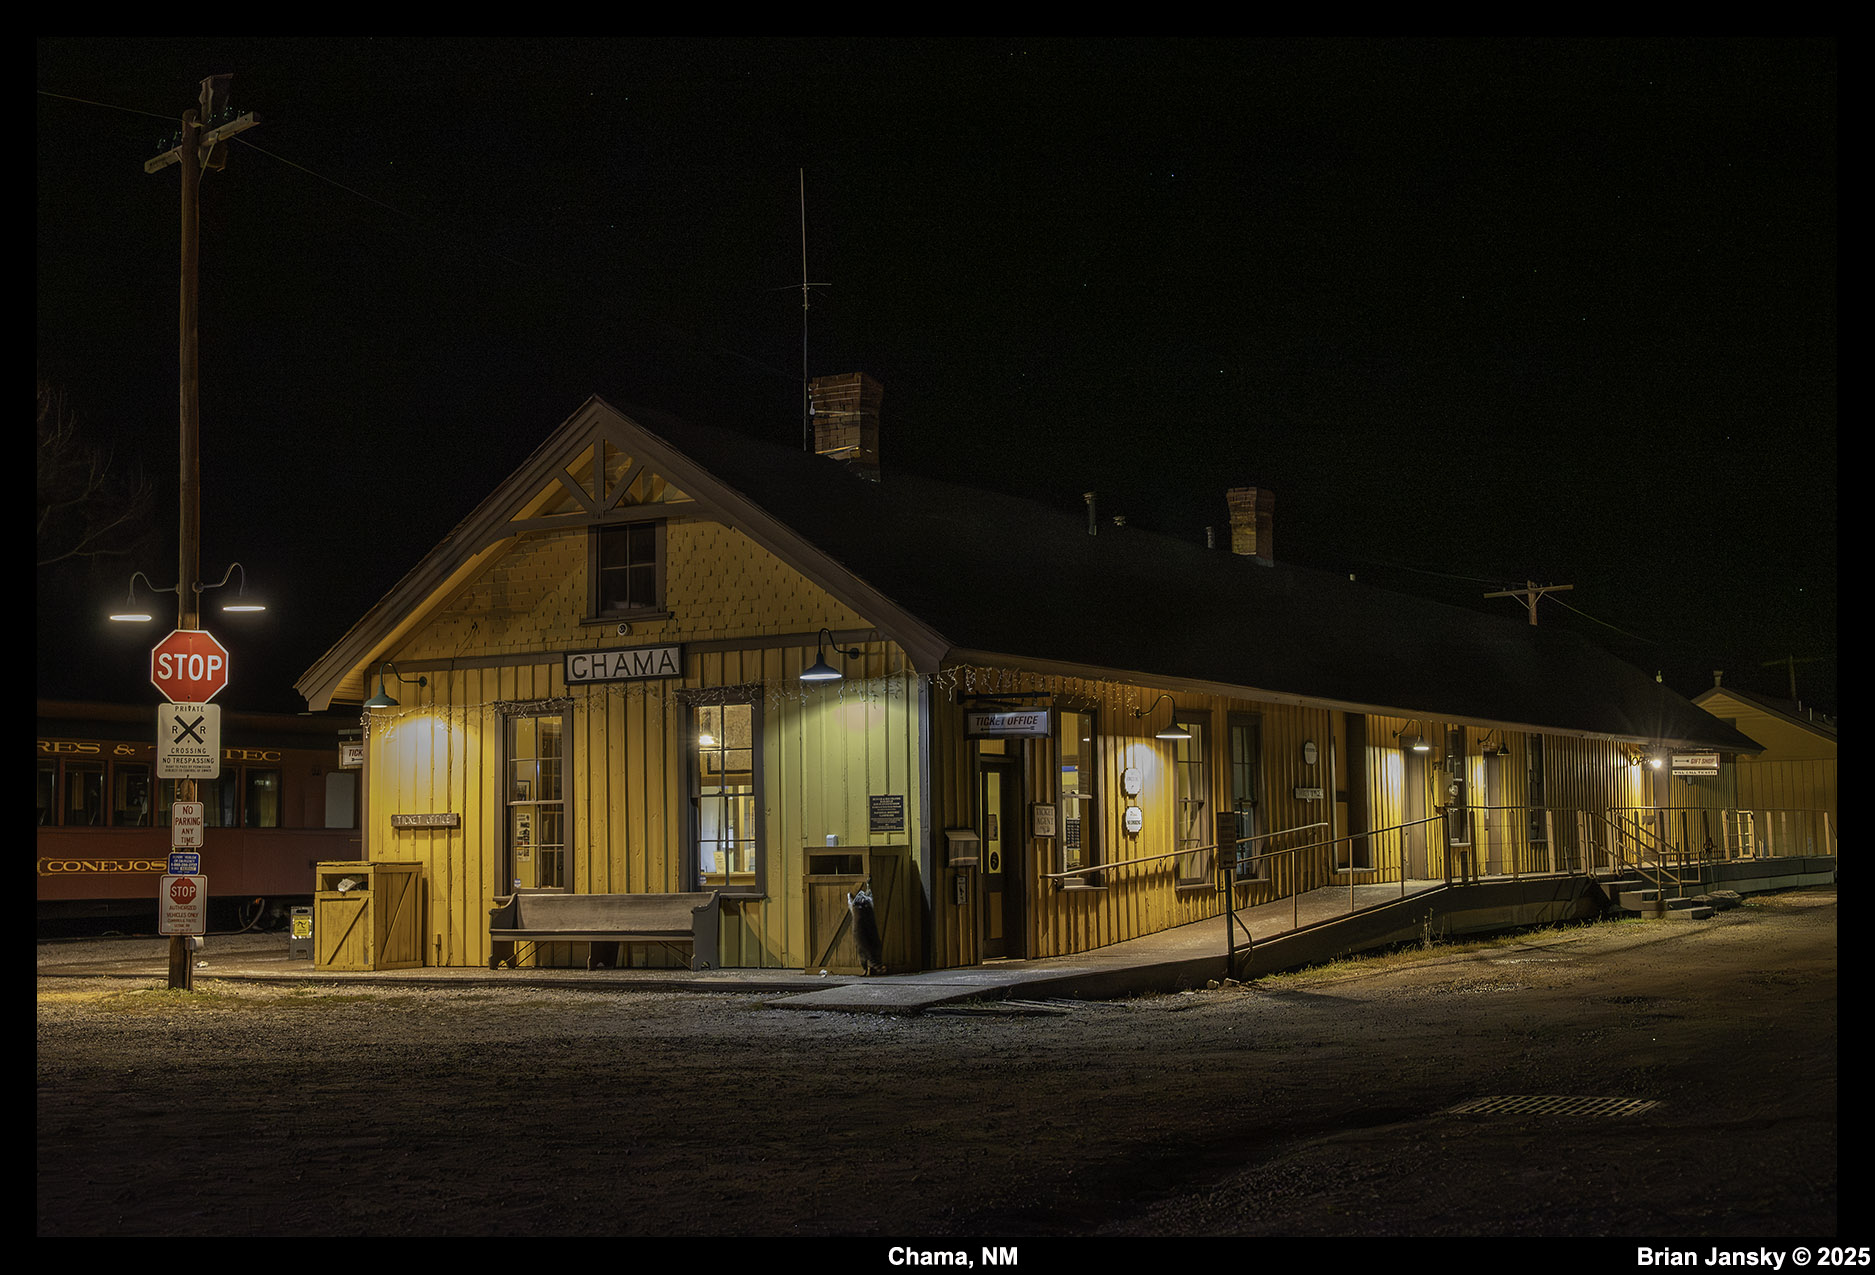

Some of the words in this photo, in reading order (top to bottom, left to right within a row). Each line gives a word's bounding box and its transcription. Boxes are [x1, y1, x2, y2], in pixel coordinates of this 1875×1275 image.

[157, 652, 223, 681] STOP
[571, 649, 677, 679] CHAMA
[976, 716, 1006, 727] TICKET
[1007, 715, 1039, 725] OFFICE
[172, 725, 178, 734] R
[200, 726, 206, 735] R
[113, 744, 135, 756] &
[183, 806, 194, 815] NO
[175, 817, 201, 826] PARKING
[397, 815, 422, 824] TICKET
[427, 814, 451, 824] OFFICE
[181, 836, 195, 844] TIME
[47, 860, 168, 872] CONEJOS
[171, 886, 196, 898] STOP
